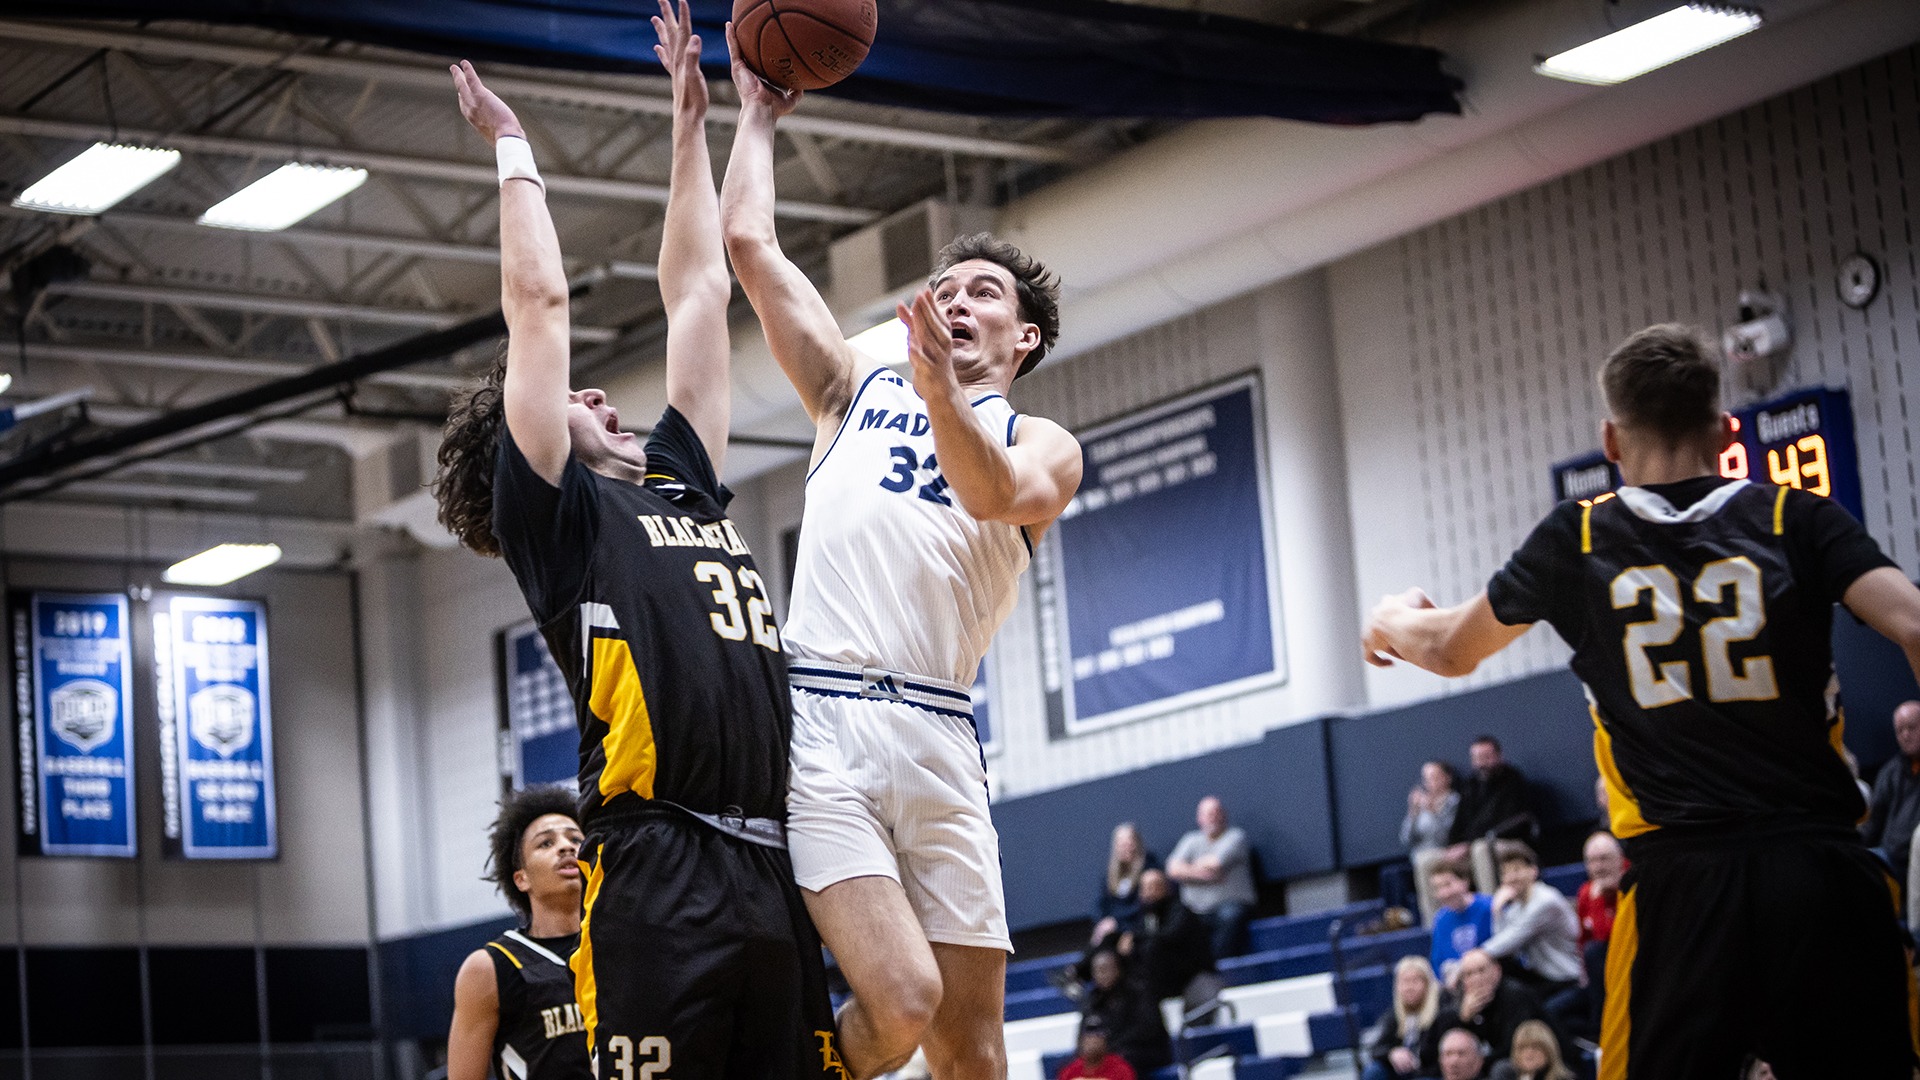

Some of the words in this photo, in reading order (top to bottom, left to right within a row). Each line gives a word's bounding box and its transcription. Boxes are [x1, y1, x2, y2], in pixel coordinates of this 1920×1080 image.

[857, 408, 933, 437] MAD
[1756, 402, 1820, 445] Guests
[879, 445, 952, 508] 32
[1768, 433, 1831, 498] 43
[53, 610, 108, 638] 2019
[692, 560, 780, 653] 32
[1608, 555, 1780, 710] 22
[540, 1002, 586, 1040] BLAC
[607, 1035, 672, 1080] 32
